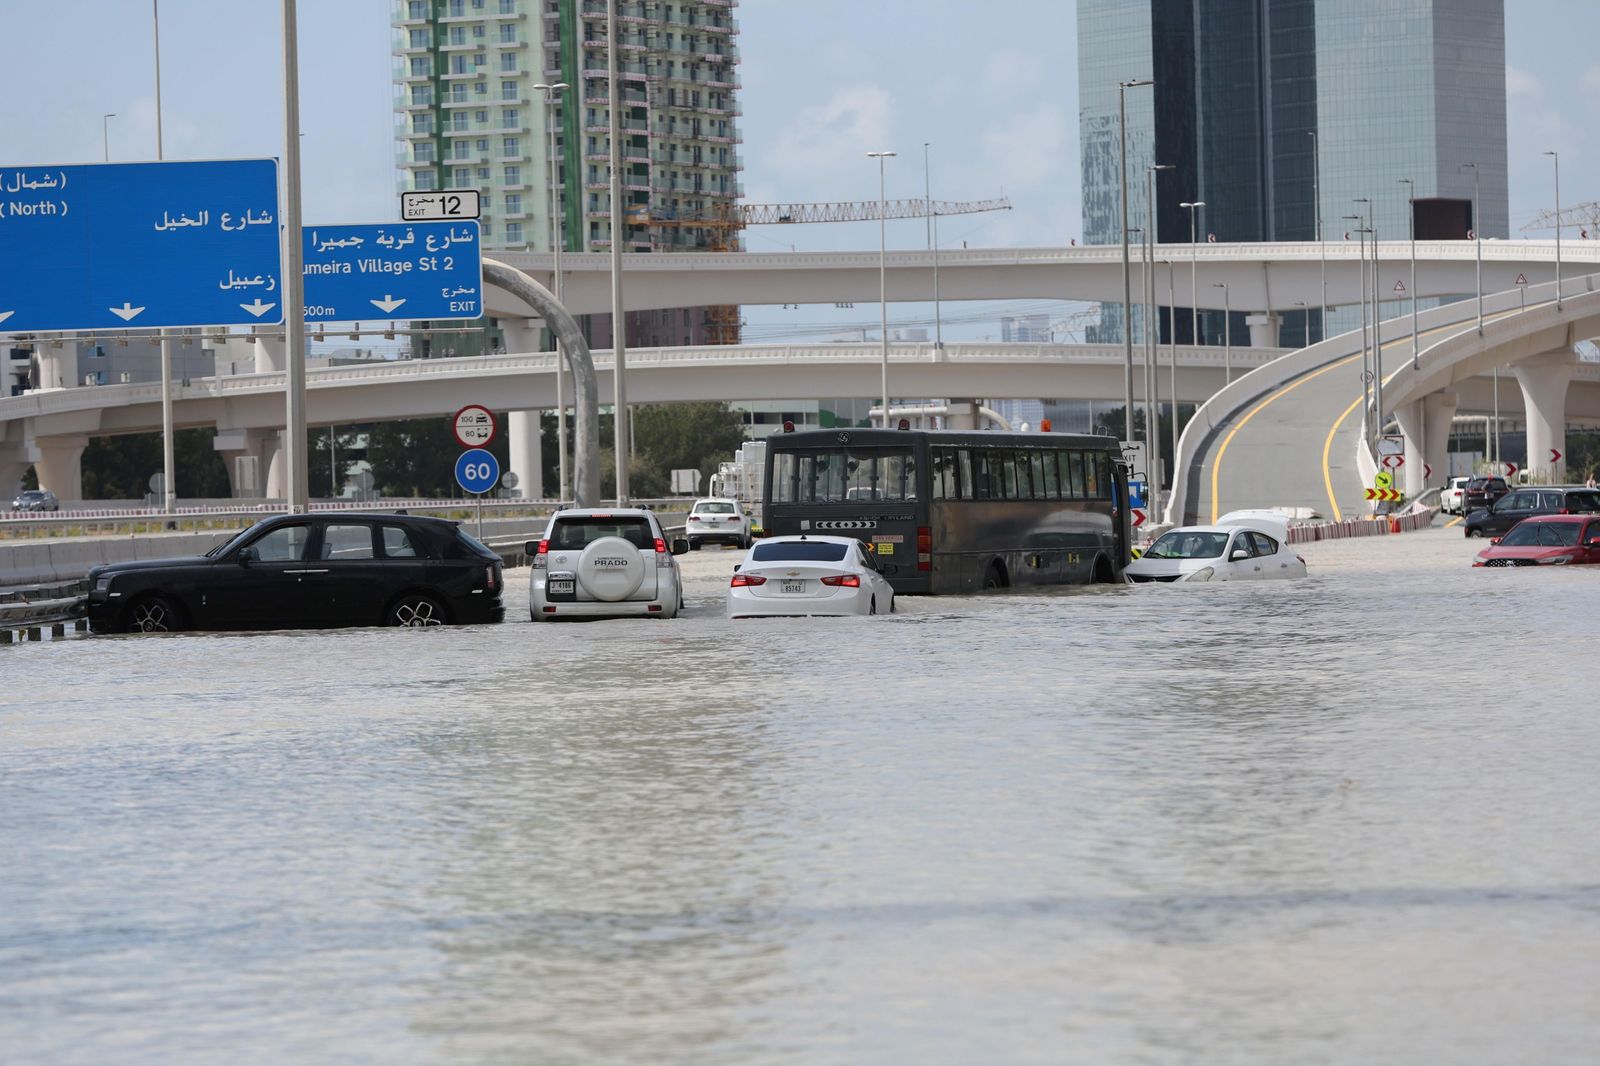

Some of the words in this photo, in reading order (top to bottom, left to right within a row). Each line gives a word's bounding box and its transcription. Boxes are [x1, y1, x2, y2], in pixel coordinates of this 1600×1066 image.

[408, 195, 435, 207] مخرج
[439, 195, 461, 215] 12
[154, 209, 209, 231] الخيل
[221, 208, 273, 231] شارع
[408, 208, 426, 217] EXIT
[312, 230, 365, 253] جميرا
[376, 227, 415, 250] قرية
[425, 227, 474, 252] شارع
[302, 260, 351, 275] umeira
[357, 258, 413, 275] Village
[418, 256, 438, 271] St
[443, 256, 454, 271] 2
[219, 269, 276, 291] زعبيل
[441, 285, 476, 298] مخرج
[450, 301, 476, 312] EXIT
[461, 415, 473, 423] 100
[1123, 454, 1136, 462] XIT
[464, 462, 491, 481] 60
